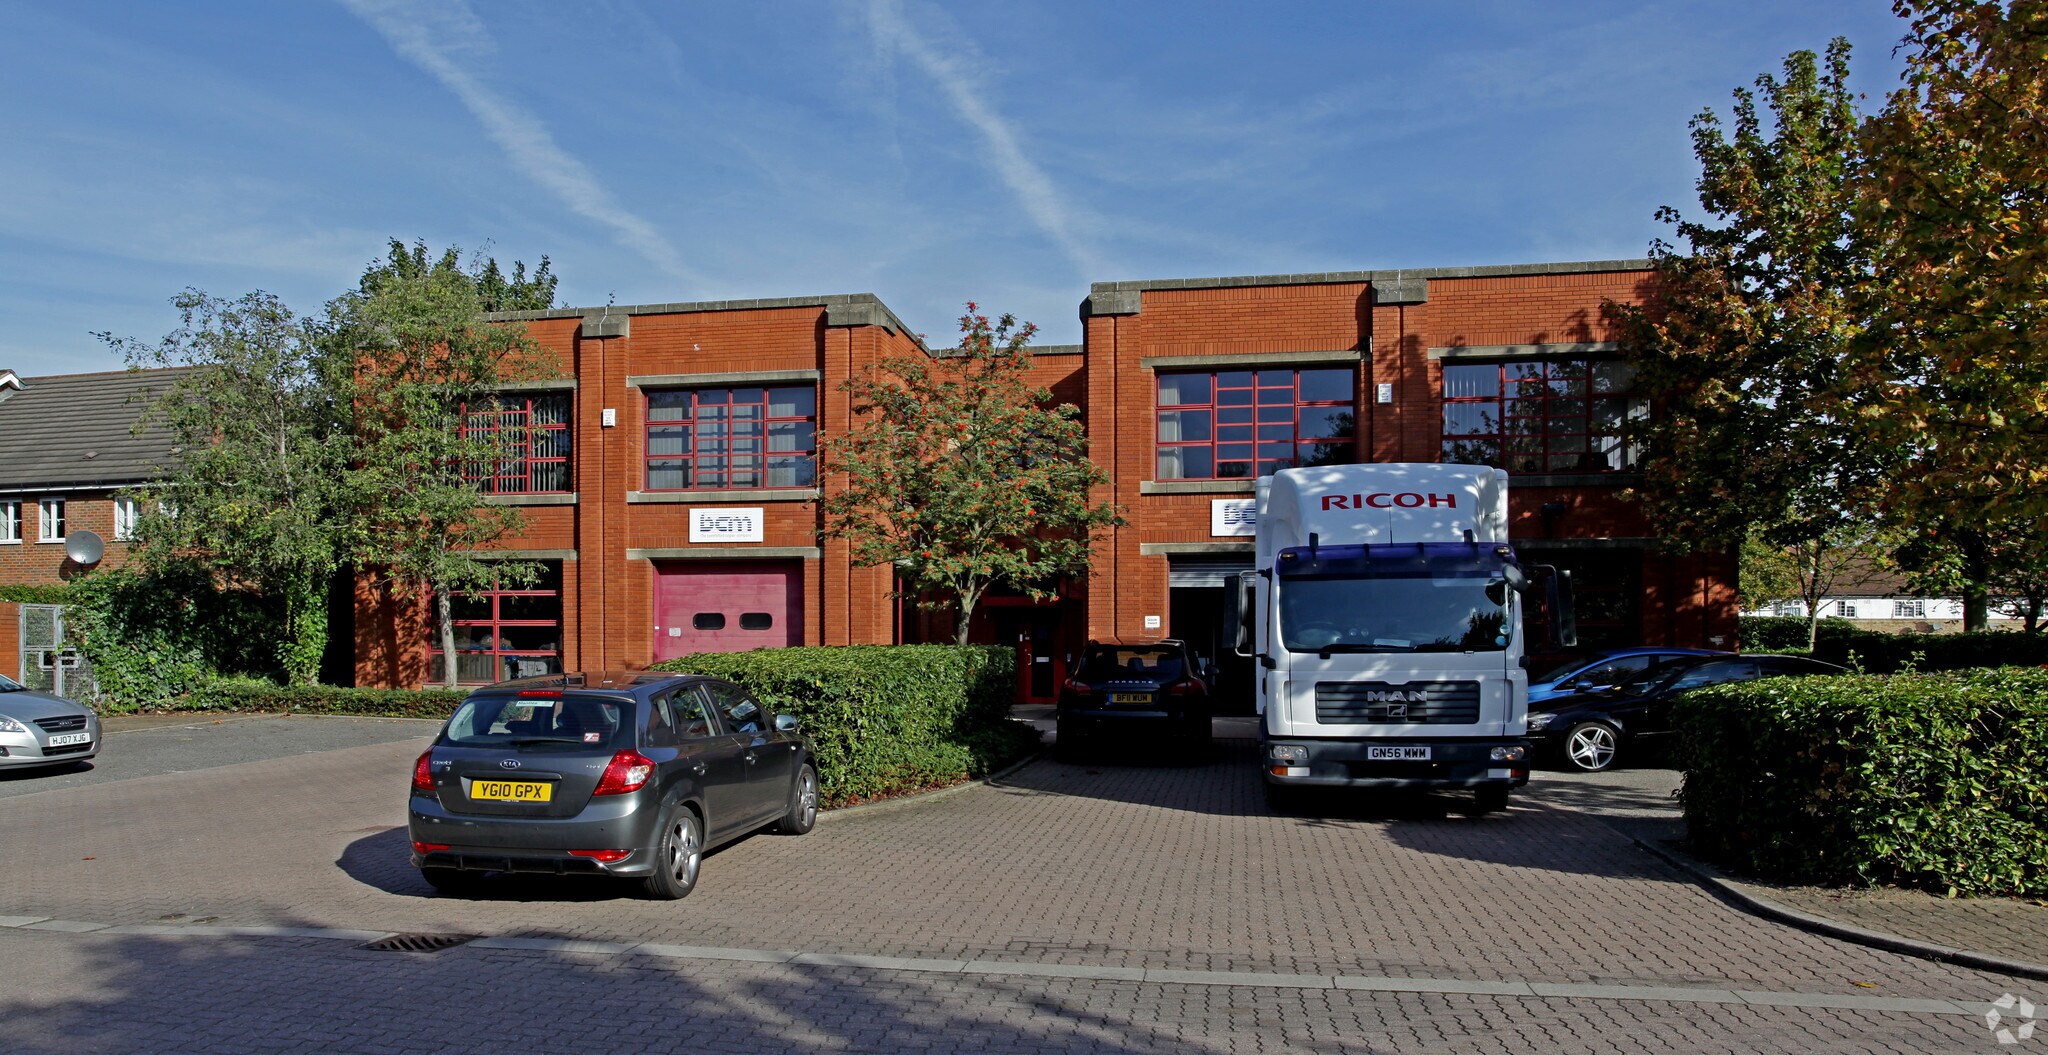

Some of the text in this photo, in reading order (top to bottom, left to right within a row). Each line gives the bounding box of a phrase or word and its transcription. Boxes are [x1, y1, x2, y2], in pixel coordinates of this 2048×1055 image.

[1321, 492, 1457, 511] RICOH
[1224, 503, 1256, 525] bc
[700, 514, 752, 532] bcm
[1367, 690, 1428, 702] MAN
[52, 733, 86, 745] HJ07 XJG
[1371, 747, 1427, 759] GN56 MWM
[481, 782, 543, 799] YG10 GPX
